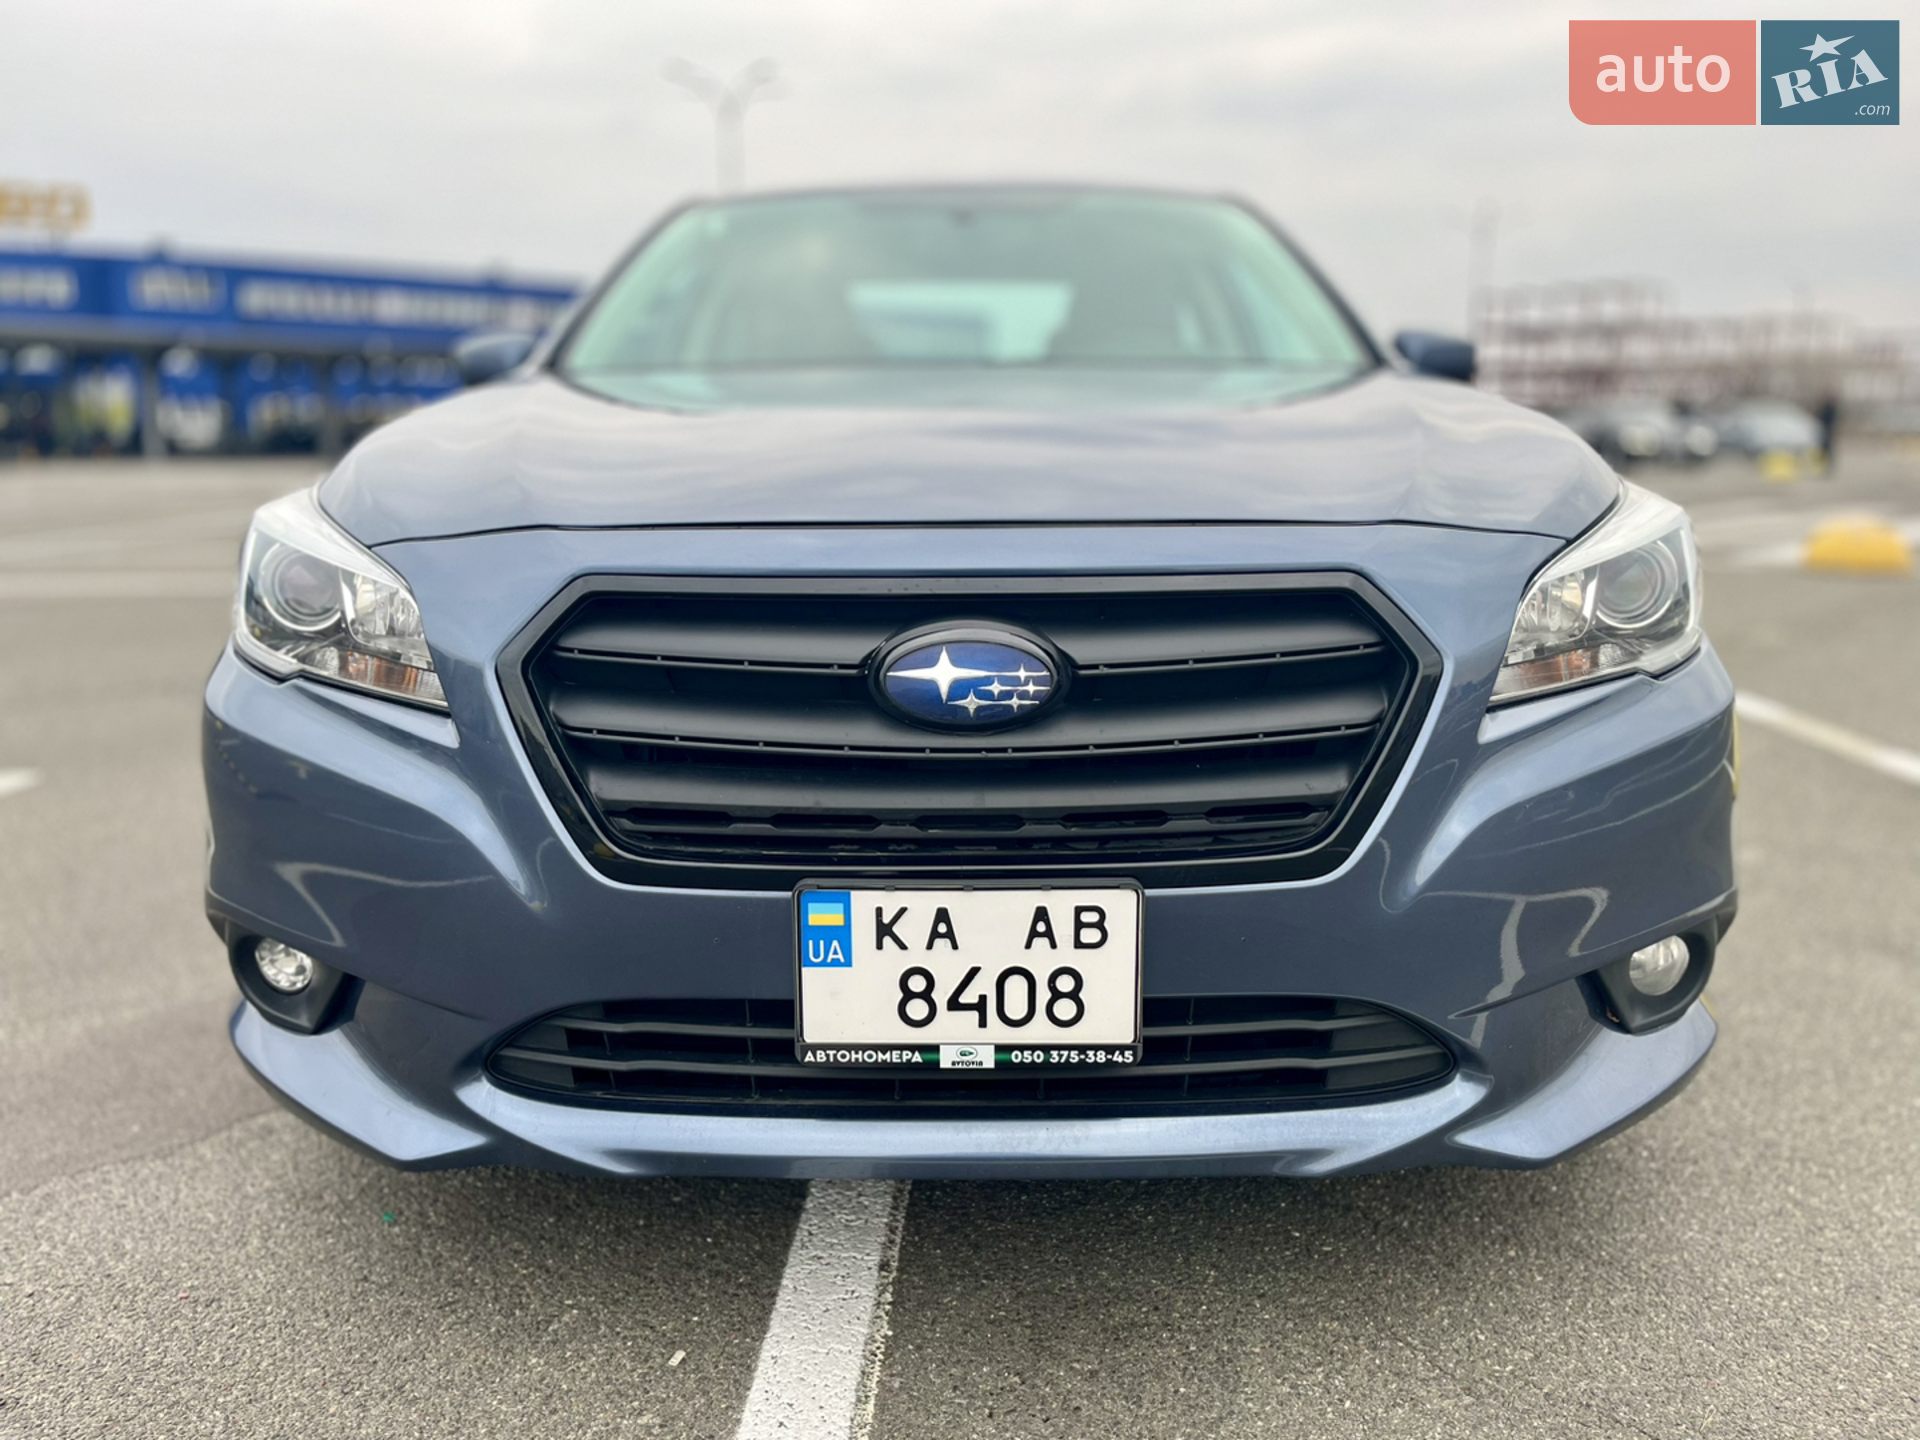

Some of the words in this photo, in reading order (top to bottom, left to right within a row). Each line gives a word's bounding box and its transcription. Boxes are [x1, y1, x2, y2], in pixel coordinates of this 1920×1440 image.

[874, 905, 960, 951] KA
[1023, 905, 1109, 950] AB
[808, 939, 845, 963] UA
[897, 965, 1086, 1029] 8408
[803, 1049, 924, 1064] АВТОНОМЕРА
[1010, 1049, 1045, 1064] 050
[1048, 1049, 1134, 1064] 375-38-45
